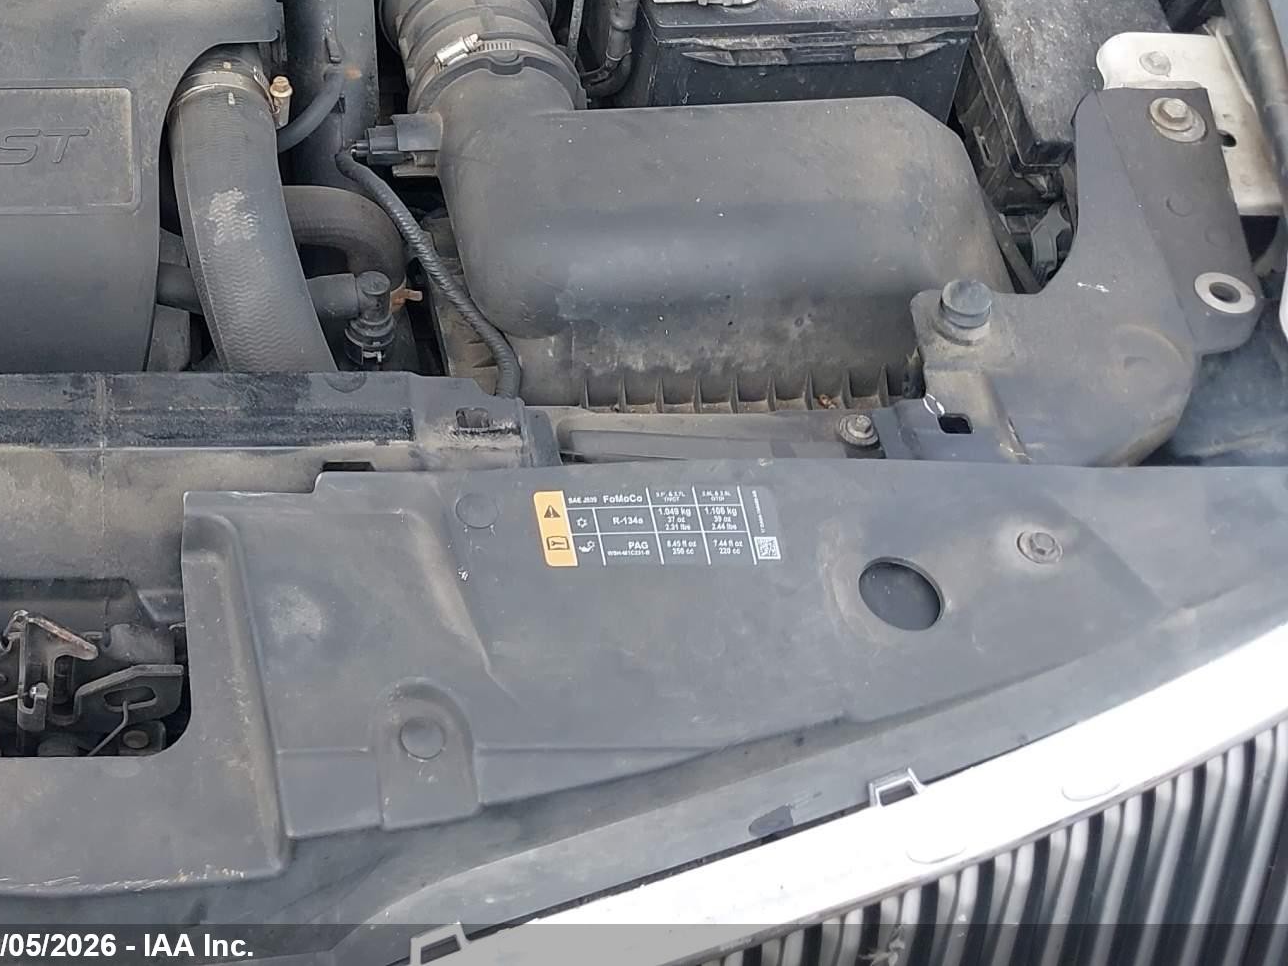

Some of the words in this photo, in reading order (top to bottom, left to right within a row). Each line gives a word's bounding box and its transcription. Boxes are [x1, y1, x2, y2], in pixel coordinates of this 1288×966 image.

[603, 494, 643, 504] FoMoCo
[681, 508, 691, 517] kg
[727, 507, 737, 517] kg
[612, 516, 644, 525] R-134a
[628, 541, 649, 549] PAG
